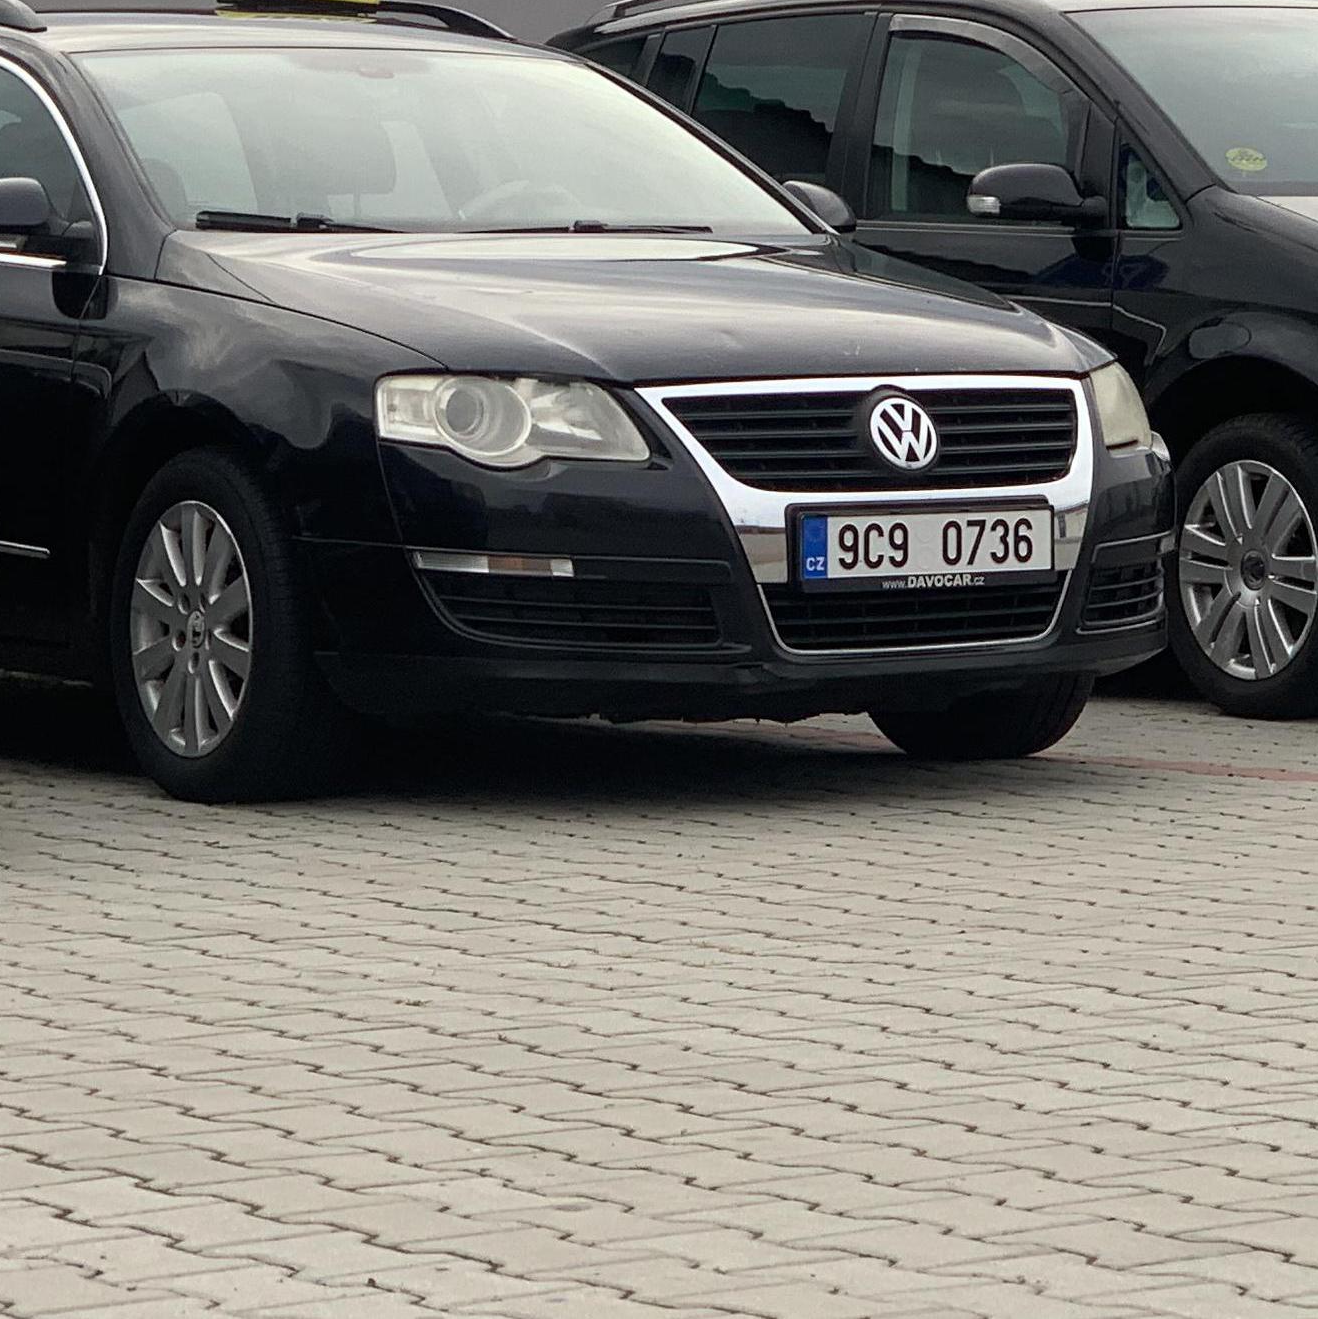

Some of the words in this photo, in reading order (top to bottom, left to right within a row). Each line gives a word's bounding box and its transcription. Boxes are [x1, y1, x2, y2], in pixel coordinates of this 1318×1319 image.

[805, 556, 825, 571] CZ
[838, 522, 910, 570] 9C9
[941, 517, 1034, 566] 0736
[882, 573, 986, 590] www.DAVOCAR.cz
